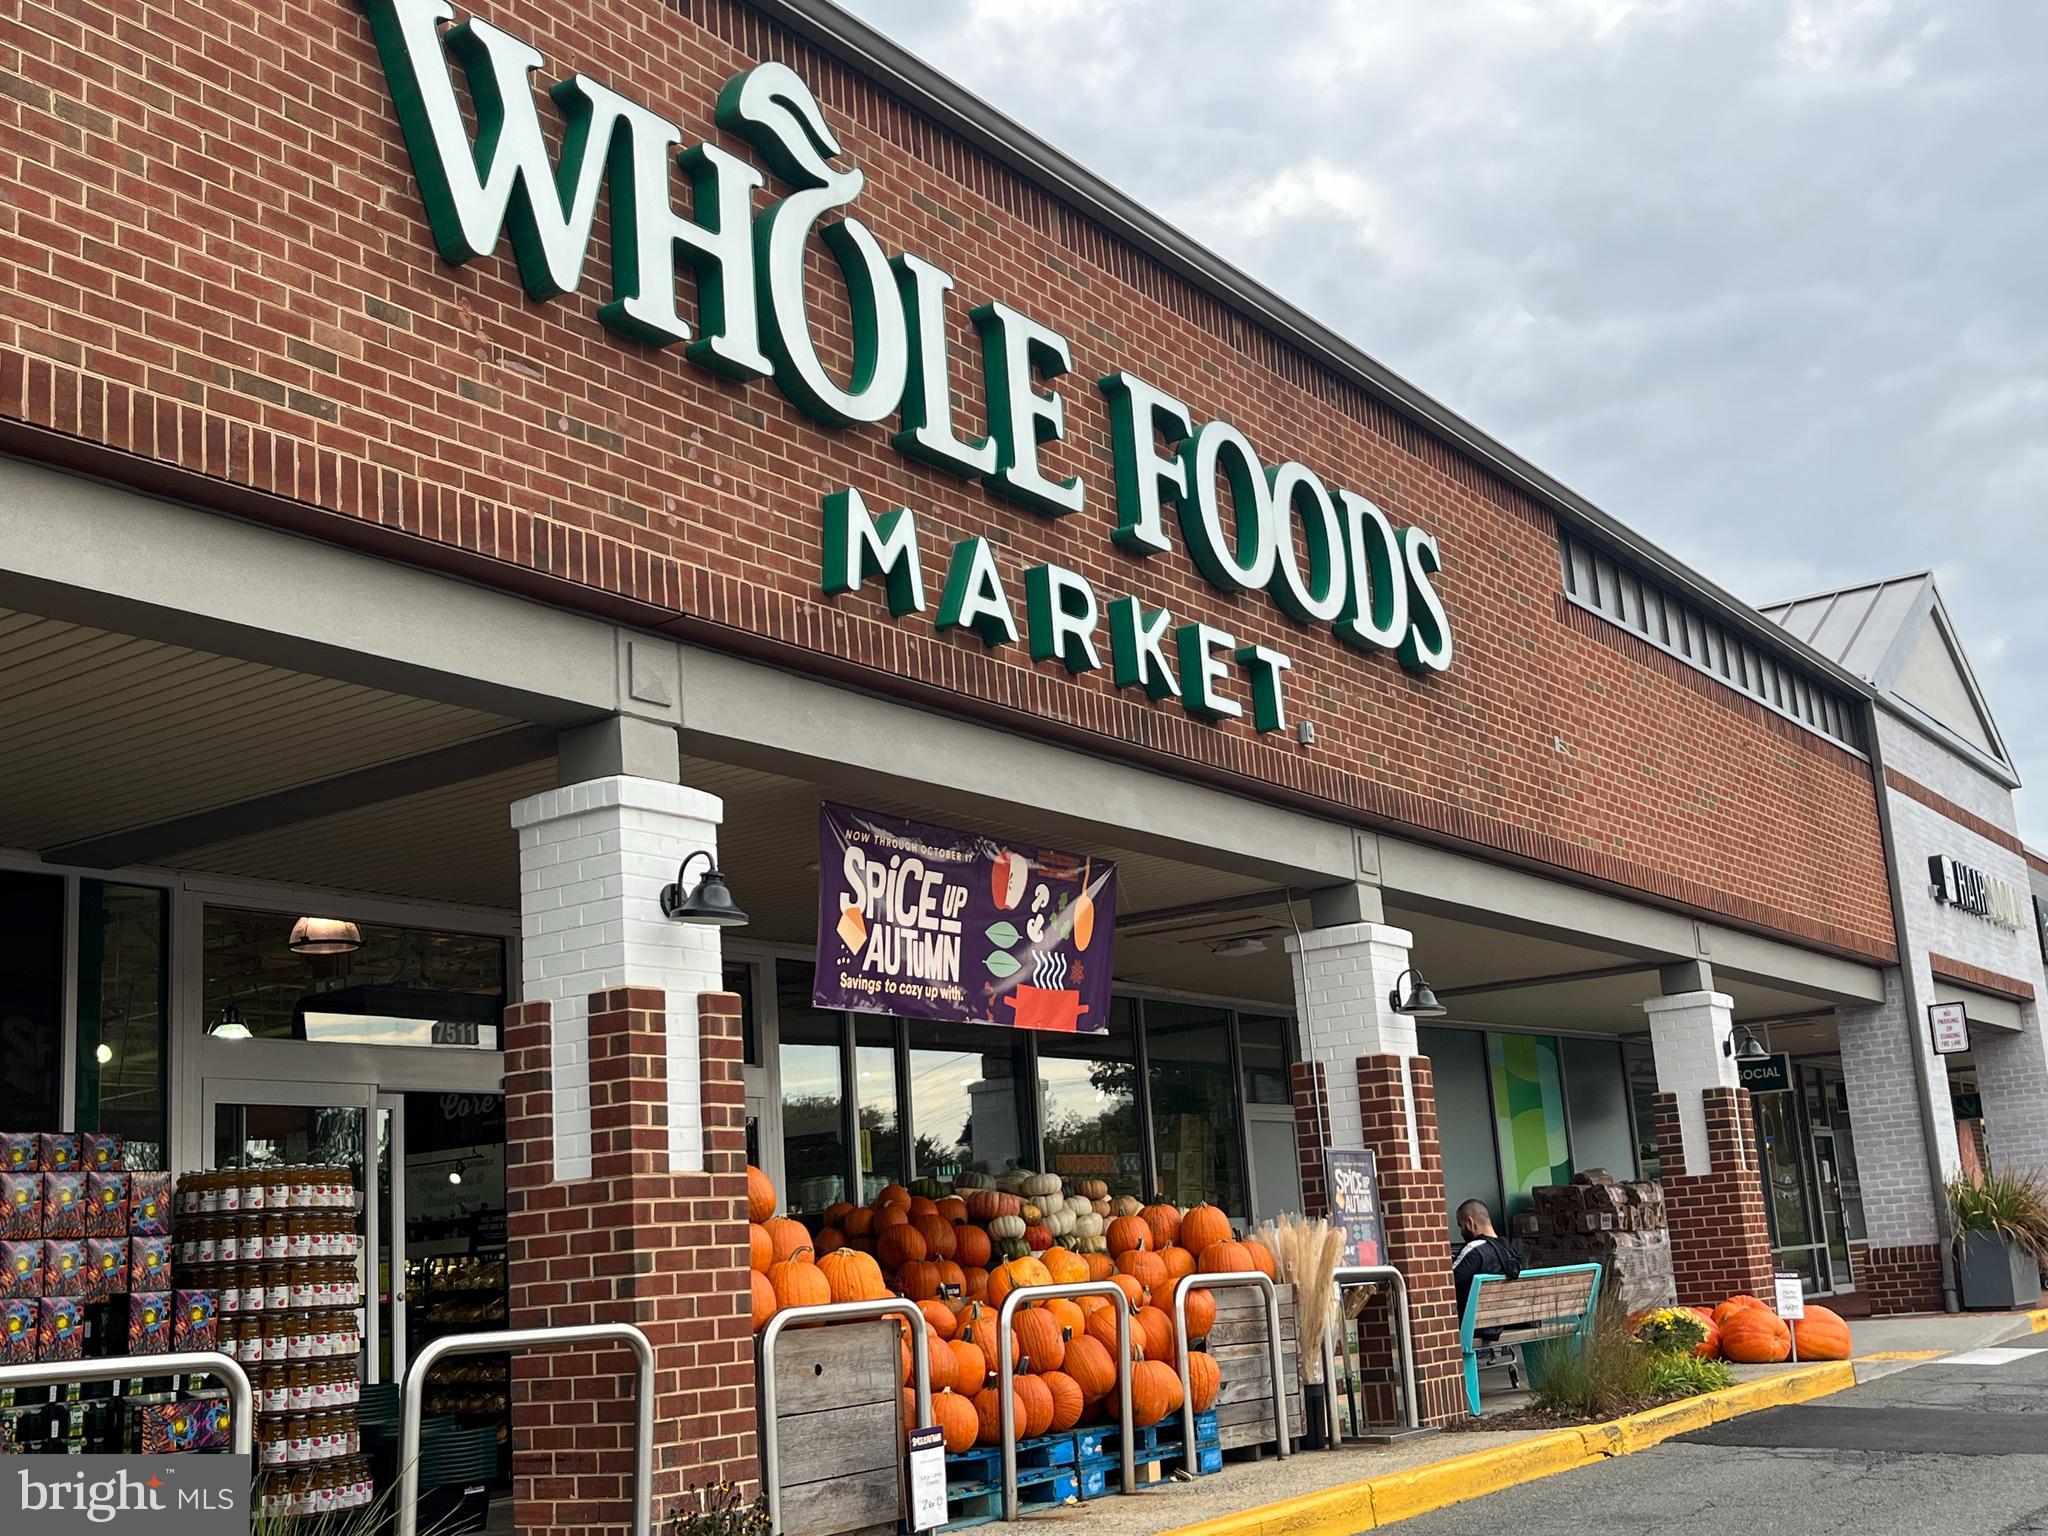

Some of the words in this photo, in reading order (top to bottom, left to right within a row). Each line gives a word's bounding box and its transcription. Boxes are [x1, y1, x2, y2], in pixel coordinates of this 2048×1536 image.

[385, 0, 1084, 515] WHOLE
[1106, 370, 1452, 674] FOODS
[834, 487, 1292, 734] MARKET
[845, 829, 871, 844] NOW
[874, 835, 918, 853] THROUGH
[920, 844, 962, 862] OCTOBER
[942, 884, 968, 919] UP
[862, 923, 961, 982] AUTUMN
[840, 971, 882, 995] Savings
[885, 978, 897, 994] to
[899, 983, 924, 1000] cozy
[925, 985, 939, 1002] up
[940, 985, 964, 1001] with.
[436, 1022, 476, 1044] 7511
